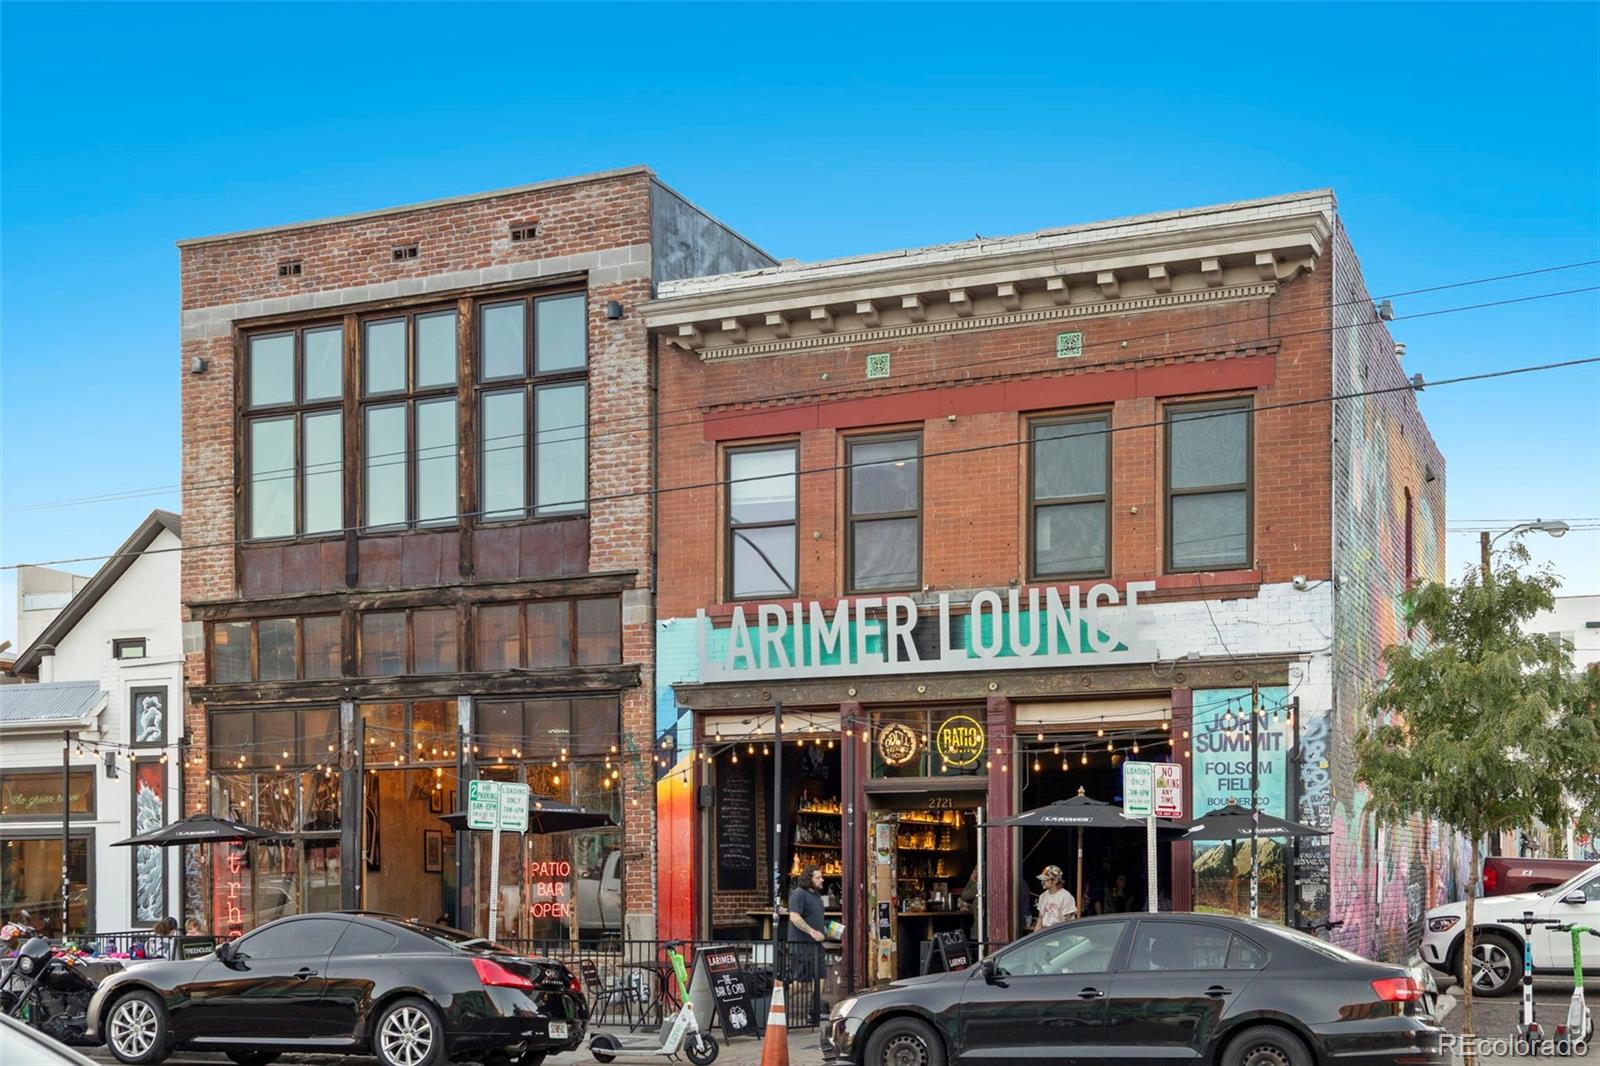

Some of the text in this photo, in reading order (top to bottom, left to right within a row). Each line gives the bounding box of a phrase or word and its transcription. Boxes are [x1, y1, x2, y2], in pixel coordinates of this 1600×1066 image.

[697, 581, 1158, 673] LARIMER LOUNGE
[1205, 713, 1268, 732] JOHN
[943, 727, 977, 747] RATIO
[1196, 732, 1282, 752] SUMMIT
[1161, 767, 1173, 777] NO
[1157, 778, 1180, 789] KING
[471, 784, 477, 799] 2
[928, 797, 953, 809] 2721
[1161, 796, 1174, 804] TIME
[1207, 797, 1250, 806] BOUDER
[531, 862, 570, 876] PATIO
[537, 882, 565, 897] BAR
[532, 903, 570, 918] OPEN
[708, 954, 736, 967] LARIMER
